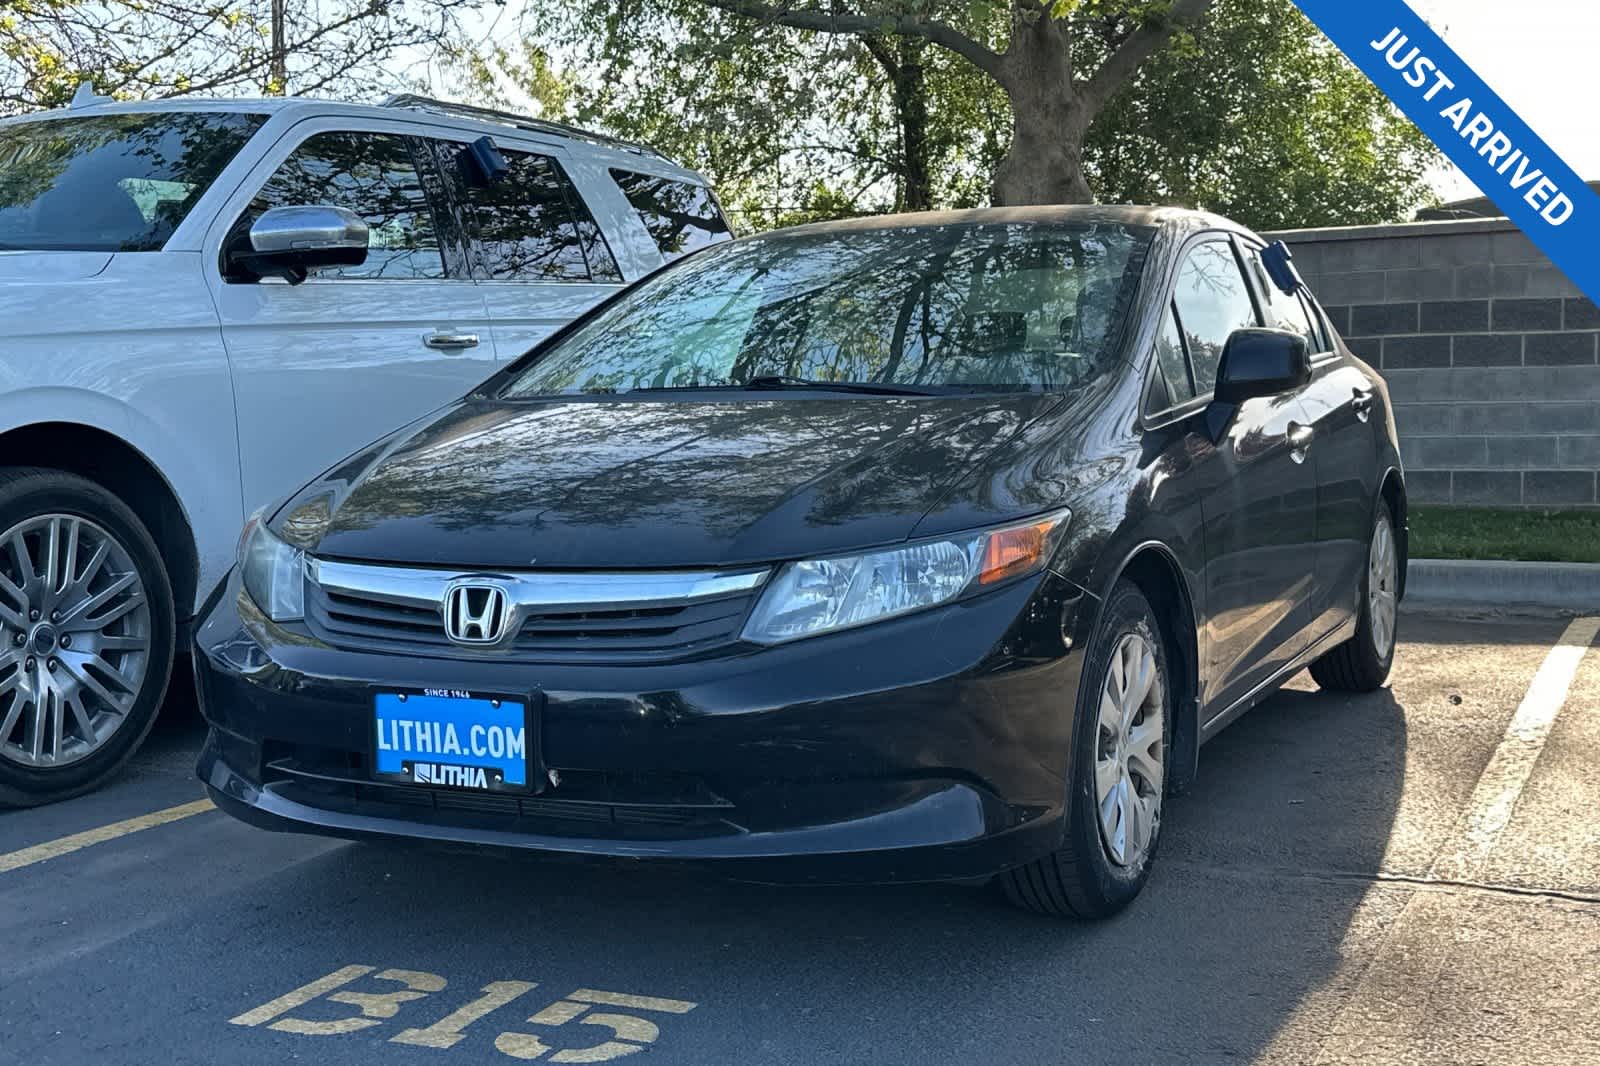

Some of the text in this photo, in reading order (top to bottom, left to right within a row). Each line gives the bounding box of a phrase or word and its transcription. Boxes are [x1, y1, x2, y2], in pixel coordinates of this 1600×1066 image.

[424, 688, 449, 697] SINCE
[377, 718, 526, 760] LITHIA.COM
[431, 765, 488, 789] LITHIA
[228, 964, 698, 1063] B15
